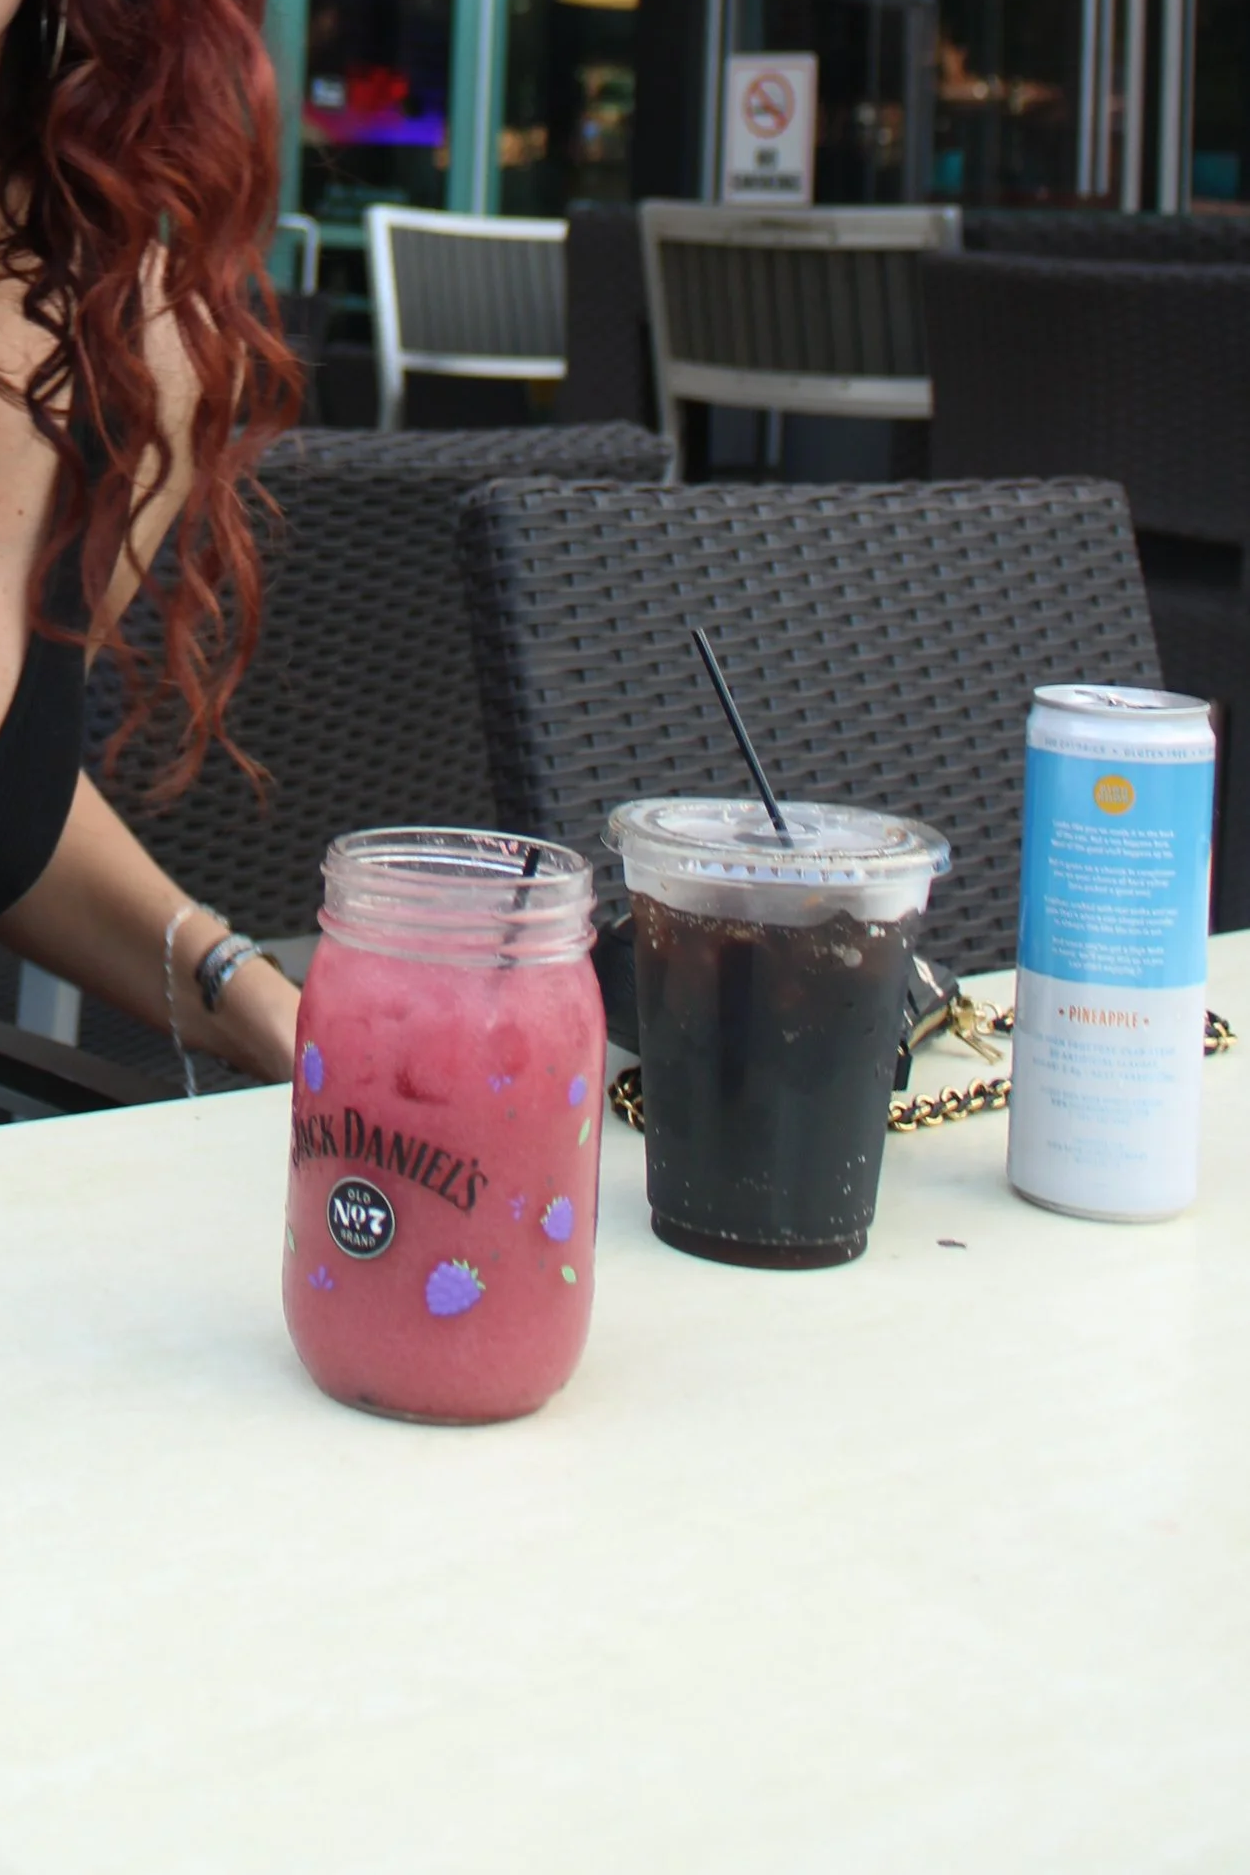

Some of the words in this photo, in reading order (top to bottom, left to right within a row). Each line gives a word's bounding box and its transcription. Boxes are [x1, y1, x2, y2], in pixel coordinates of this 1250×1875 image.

[1069, 1005, 1138, 1029] PINEAPPLE
[344, 1107, 489, 1213] DANIEL'S
[347, 1188, 371, 1205] OLD
[340, 1227, 376, 1249] BRAND
